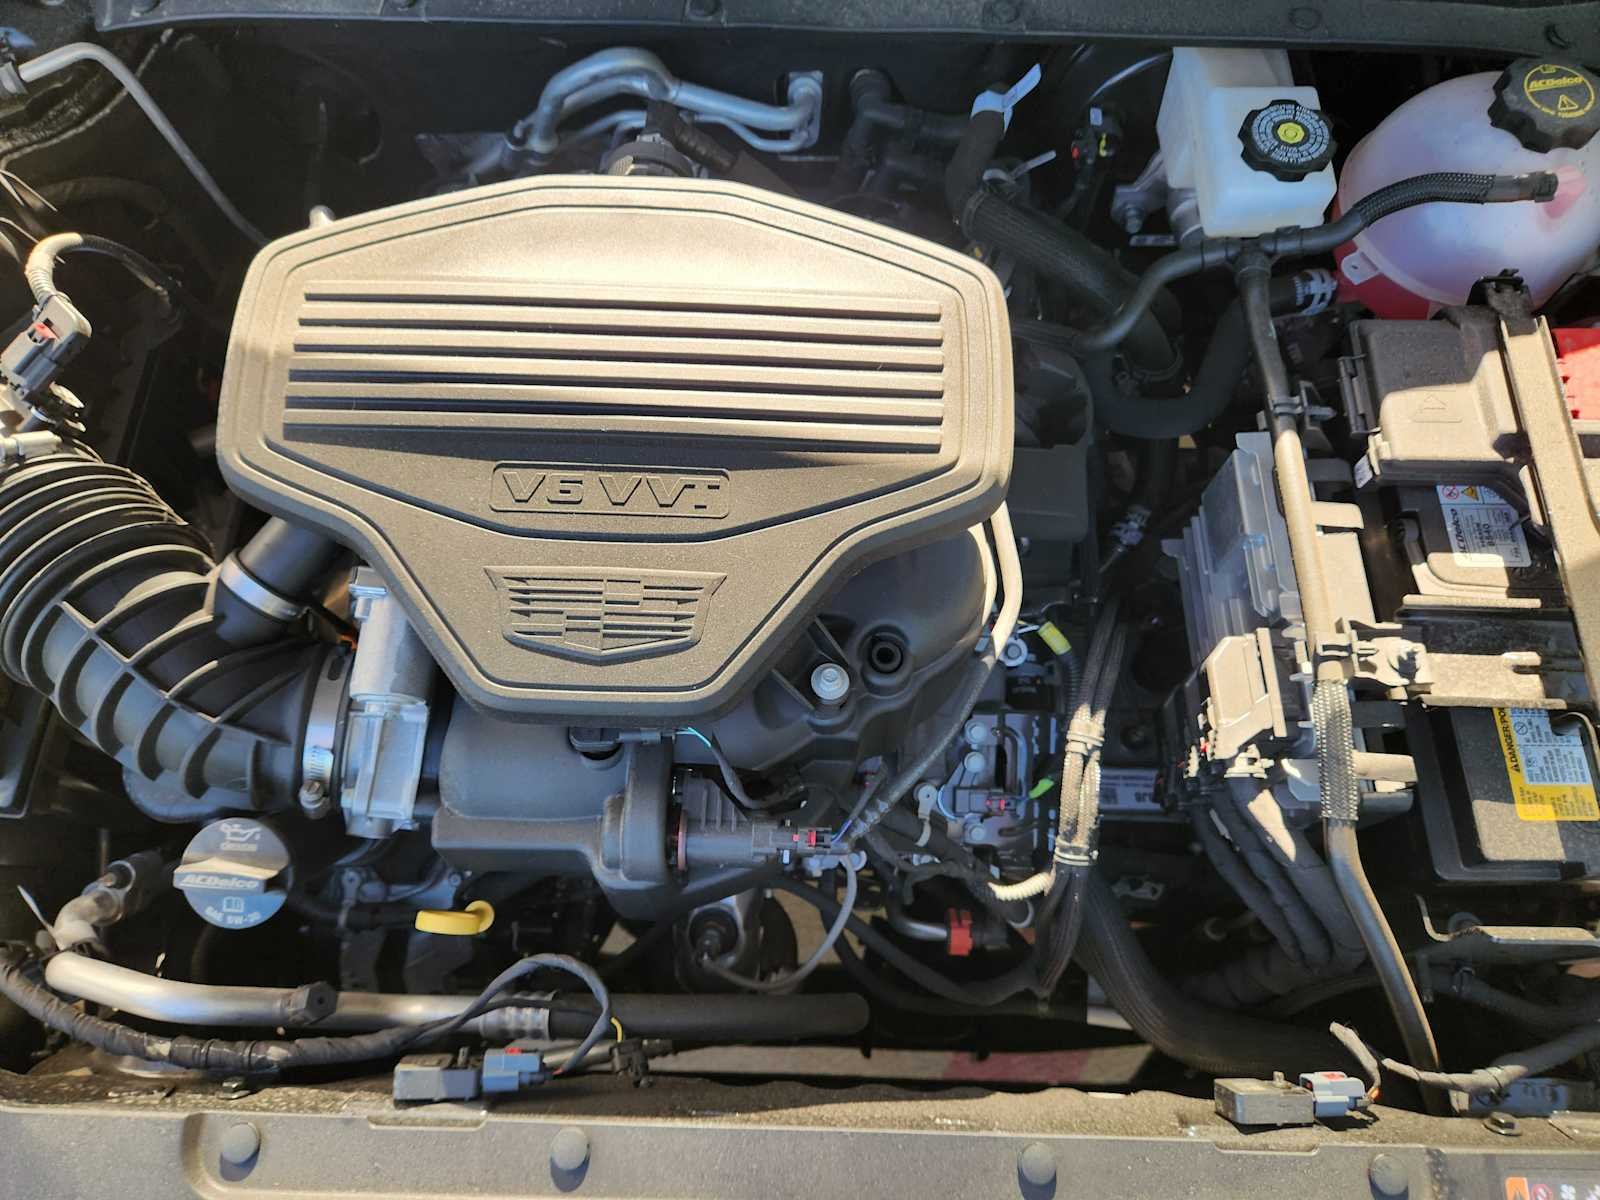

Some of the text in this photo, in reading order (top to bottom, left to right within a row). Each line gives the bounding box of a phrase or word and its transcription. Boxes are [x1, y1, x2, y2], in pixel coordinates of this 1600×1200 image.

[502, 471, 721, 510] V6 VVT
[181, 874, 259, 889] ACDelco
